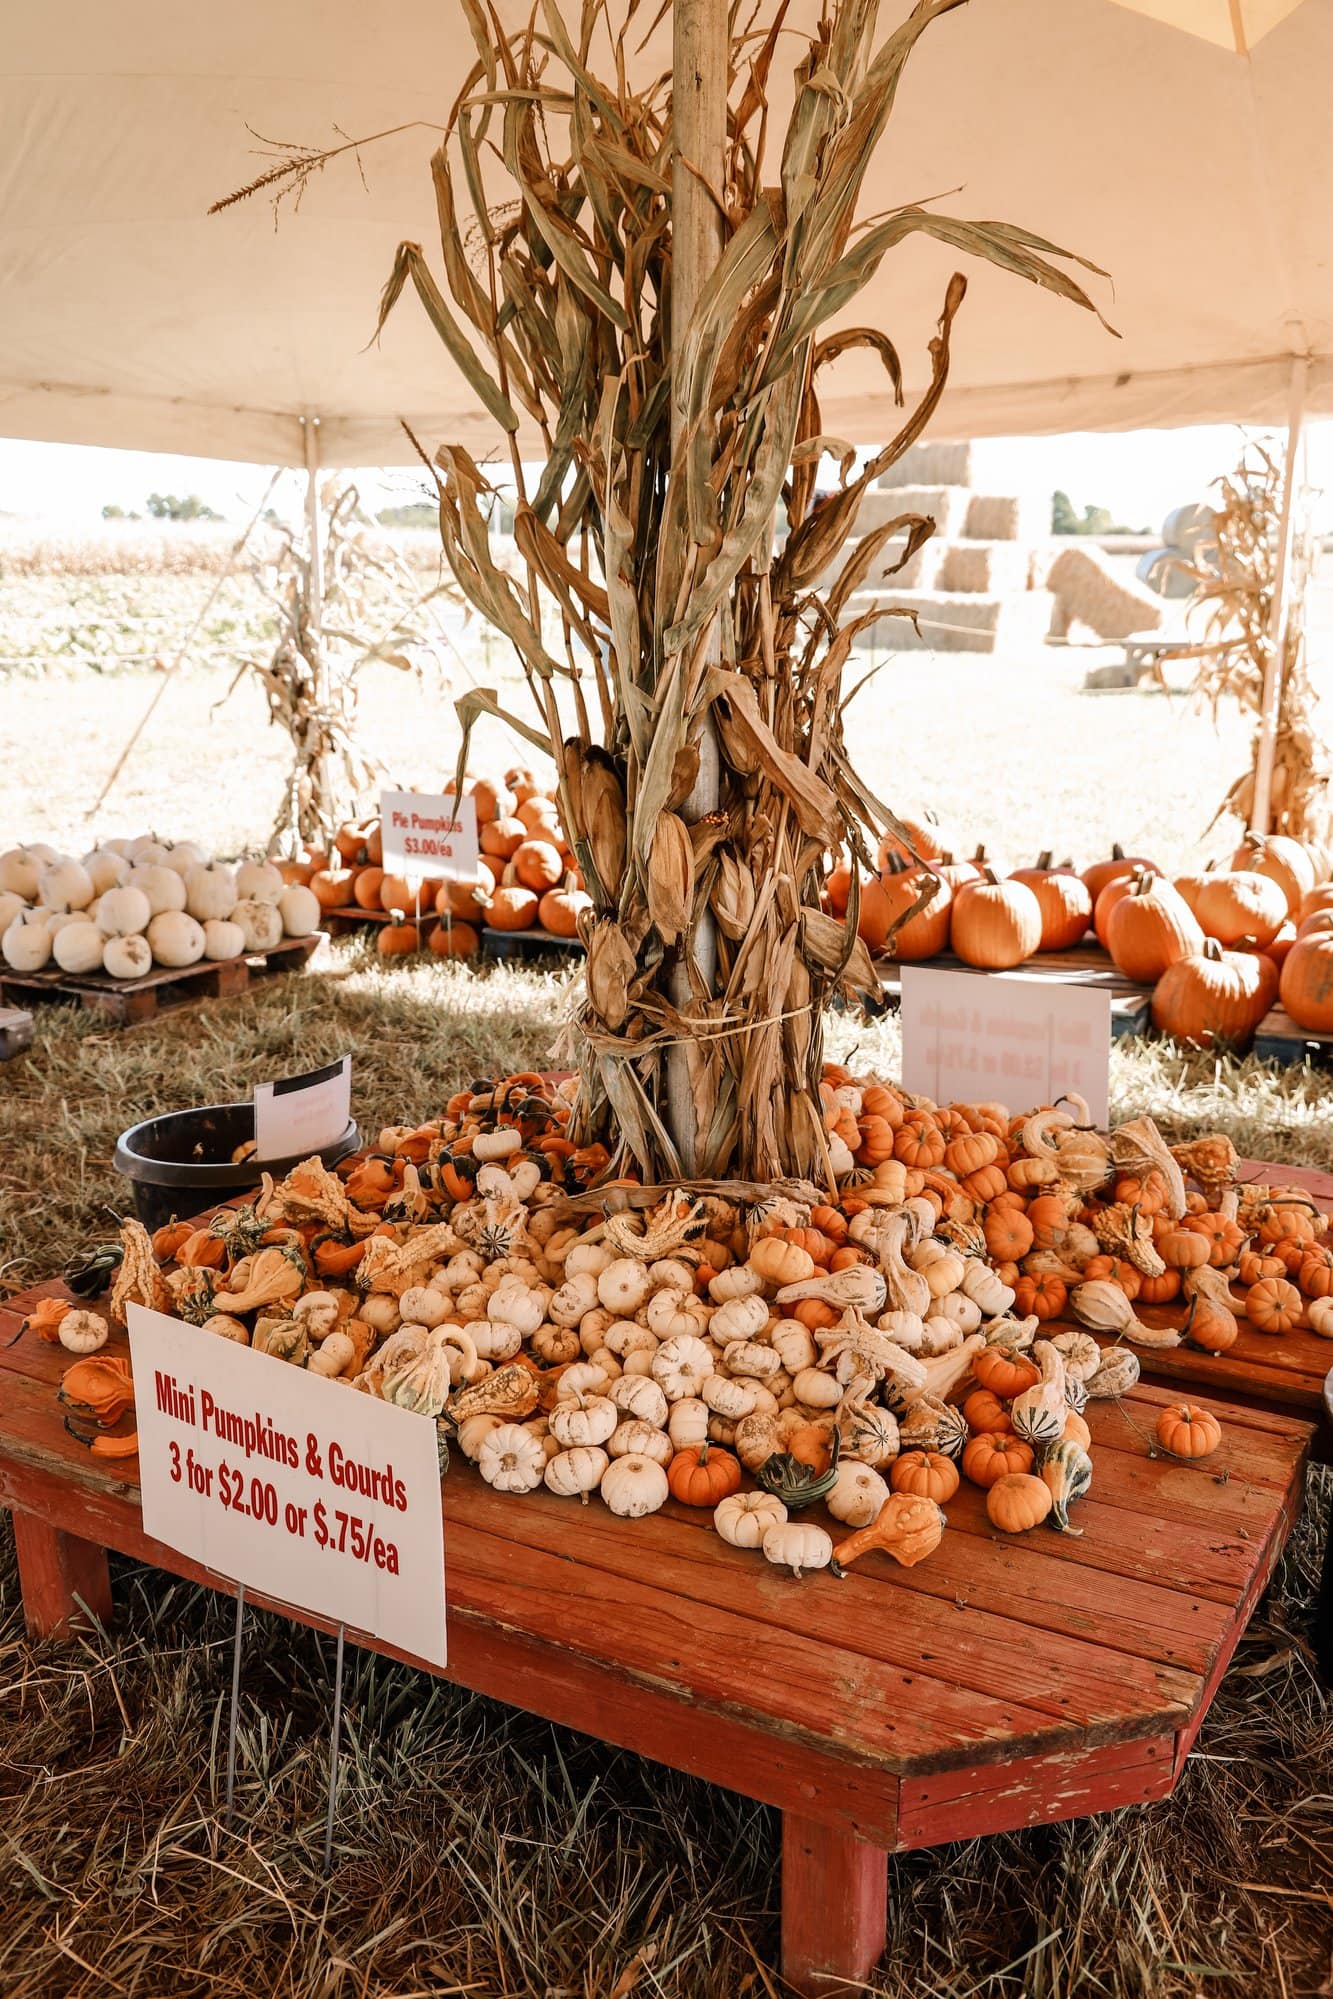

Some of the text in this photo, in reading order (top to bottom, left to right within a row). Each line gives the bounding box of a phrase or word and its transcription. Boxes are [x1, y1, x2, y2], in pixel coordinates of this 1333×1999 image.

[392, 811, 409, 828] Pie
[404, 837, 453, 857] $3.00/ea
[154, 1370, 408, 1513] Mini Pumpkins & Gourds
[168, 1440, 400, 1576] 3 for $2.00 or $.75/ea
